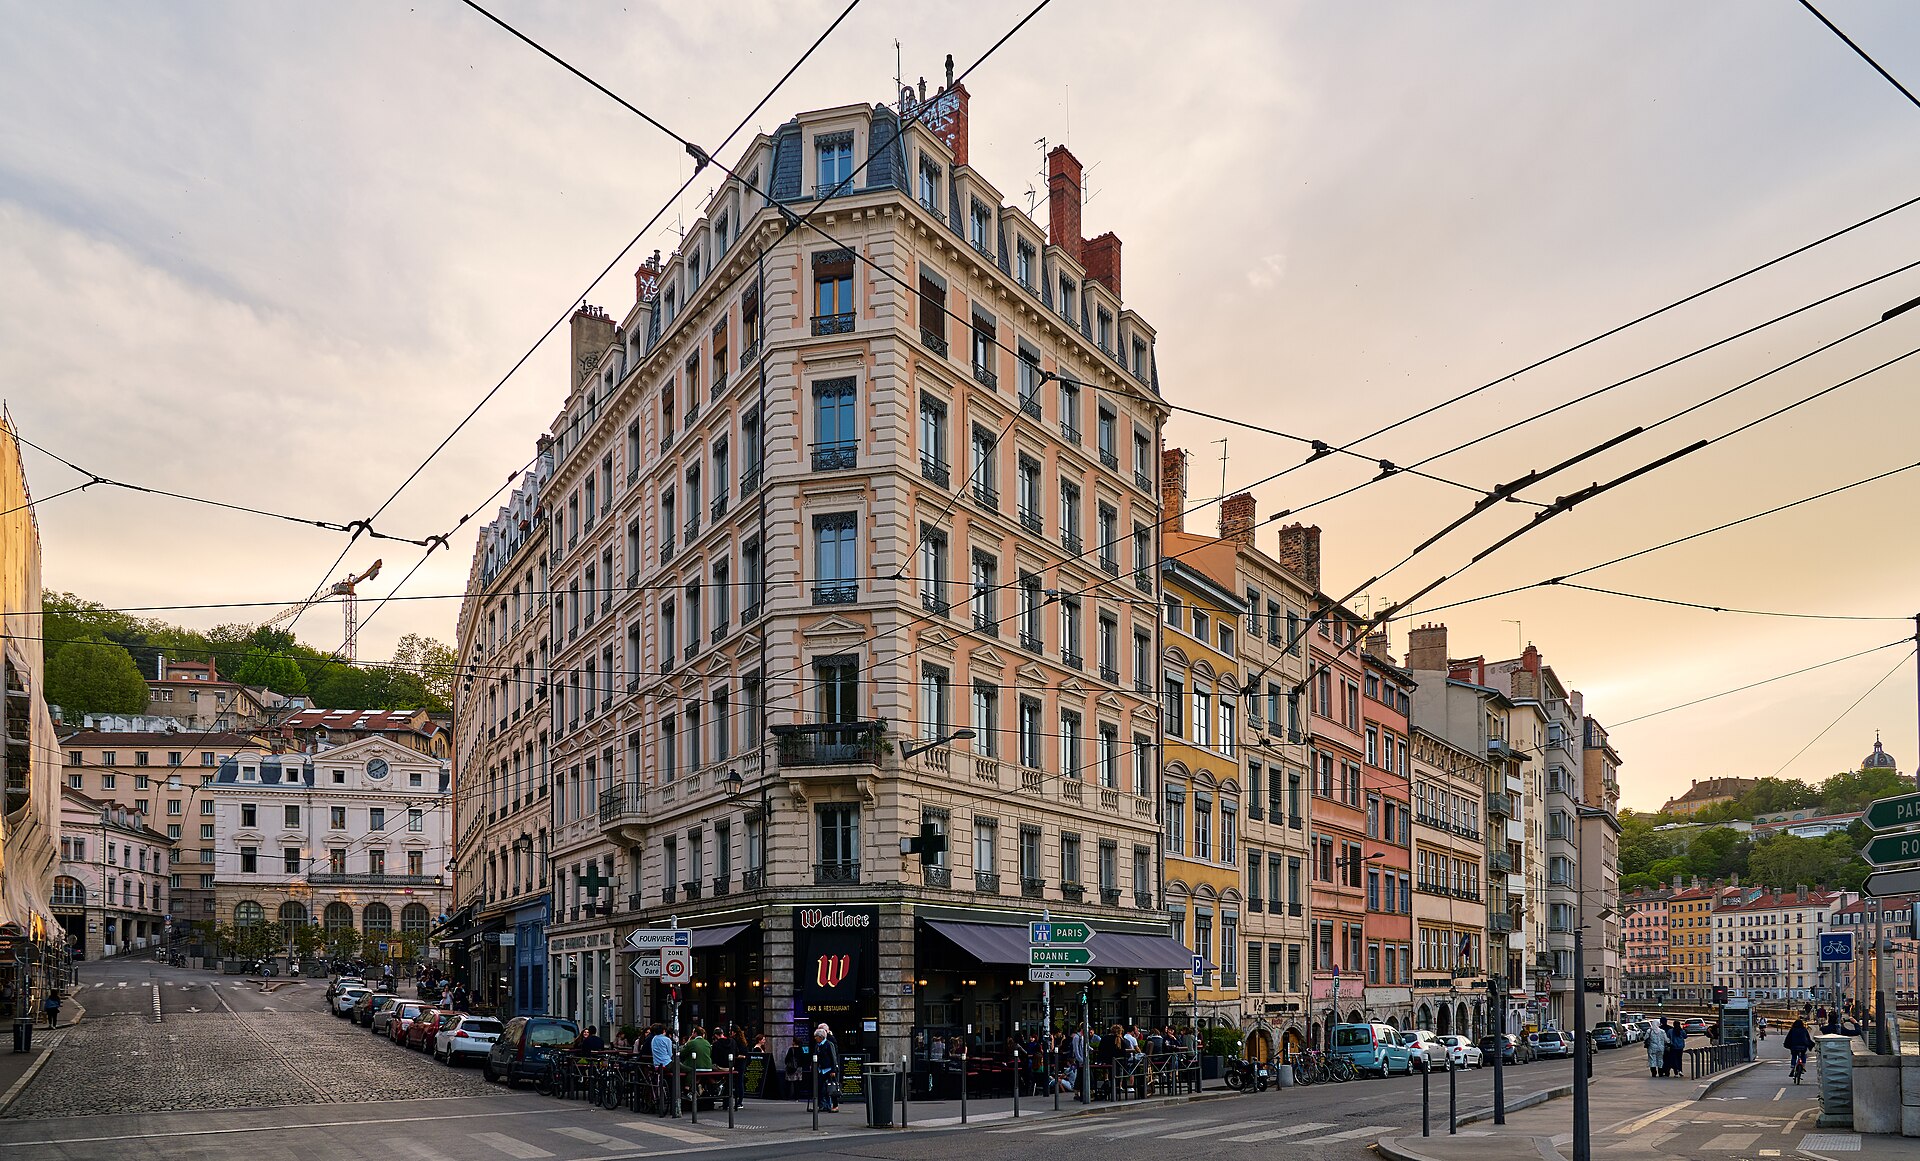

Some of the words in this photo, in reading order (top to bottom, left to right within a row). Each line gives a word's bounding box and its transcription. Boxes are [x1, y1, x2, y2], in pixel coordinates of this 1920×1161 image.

[1902, 839, 1920, 855] RO
[801, 909, 869, 928] Wallace
[1056, 928, 1083, 937] PARIS
[1033, 952, 1069, 960] ROANNE
[1196, 960, 1200, 972] P
[1033, 971, 1055, 979] VAISE
